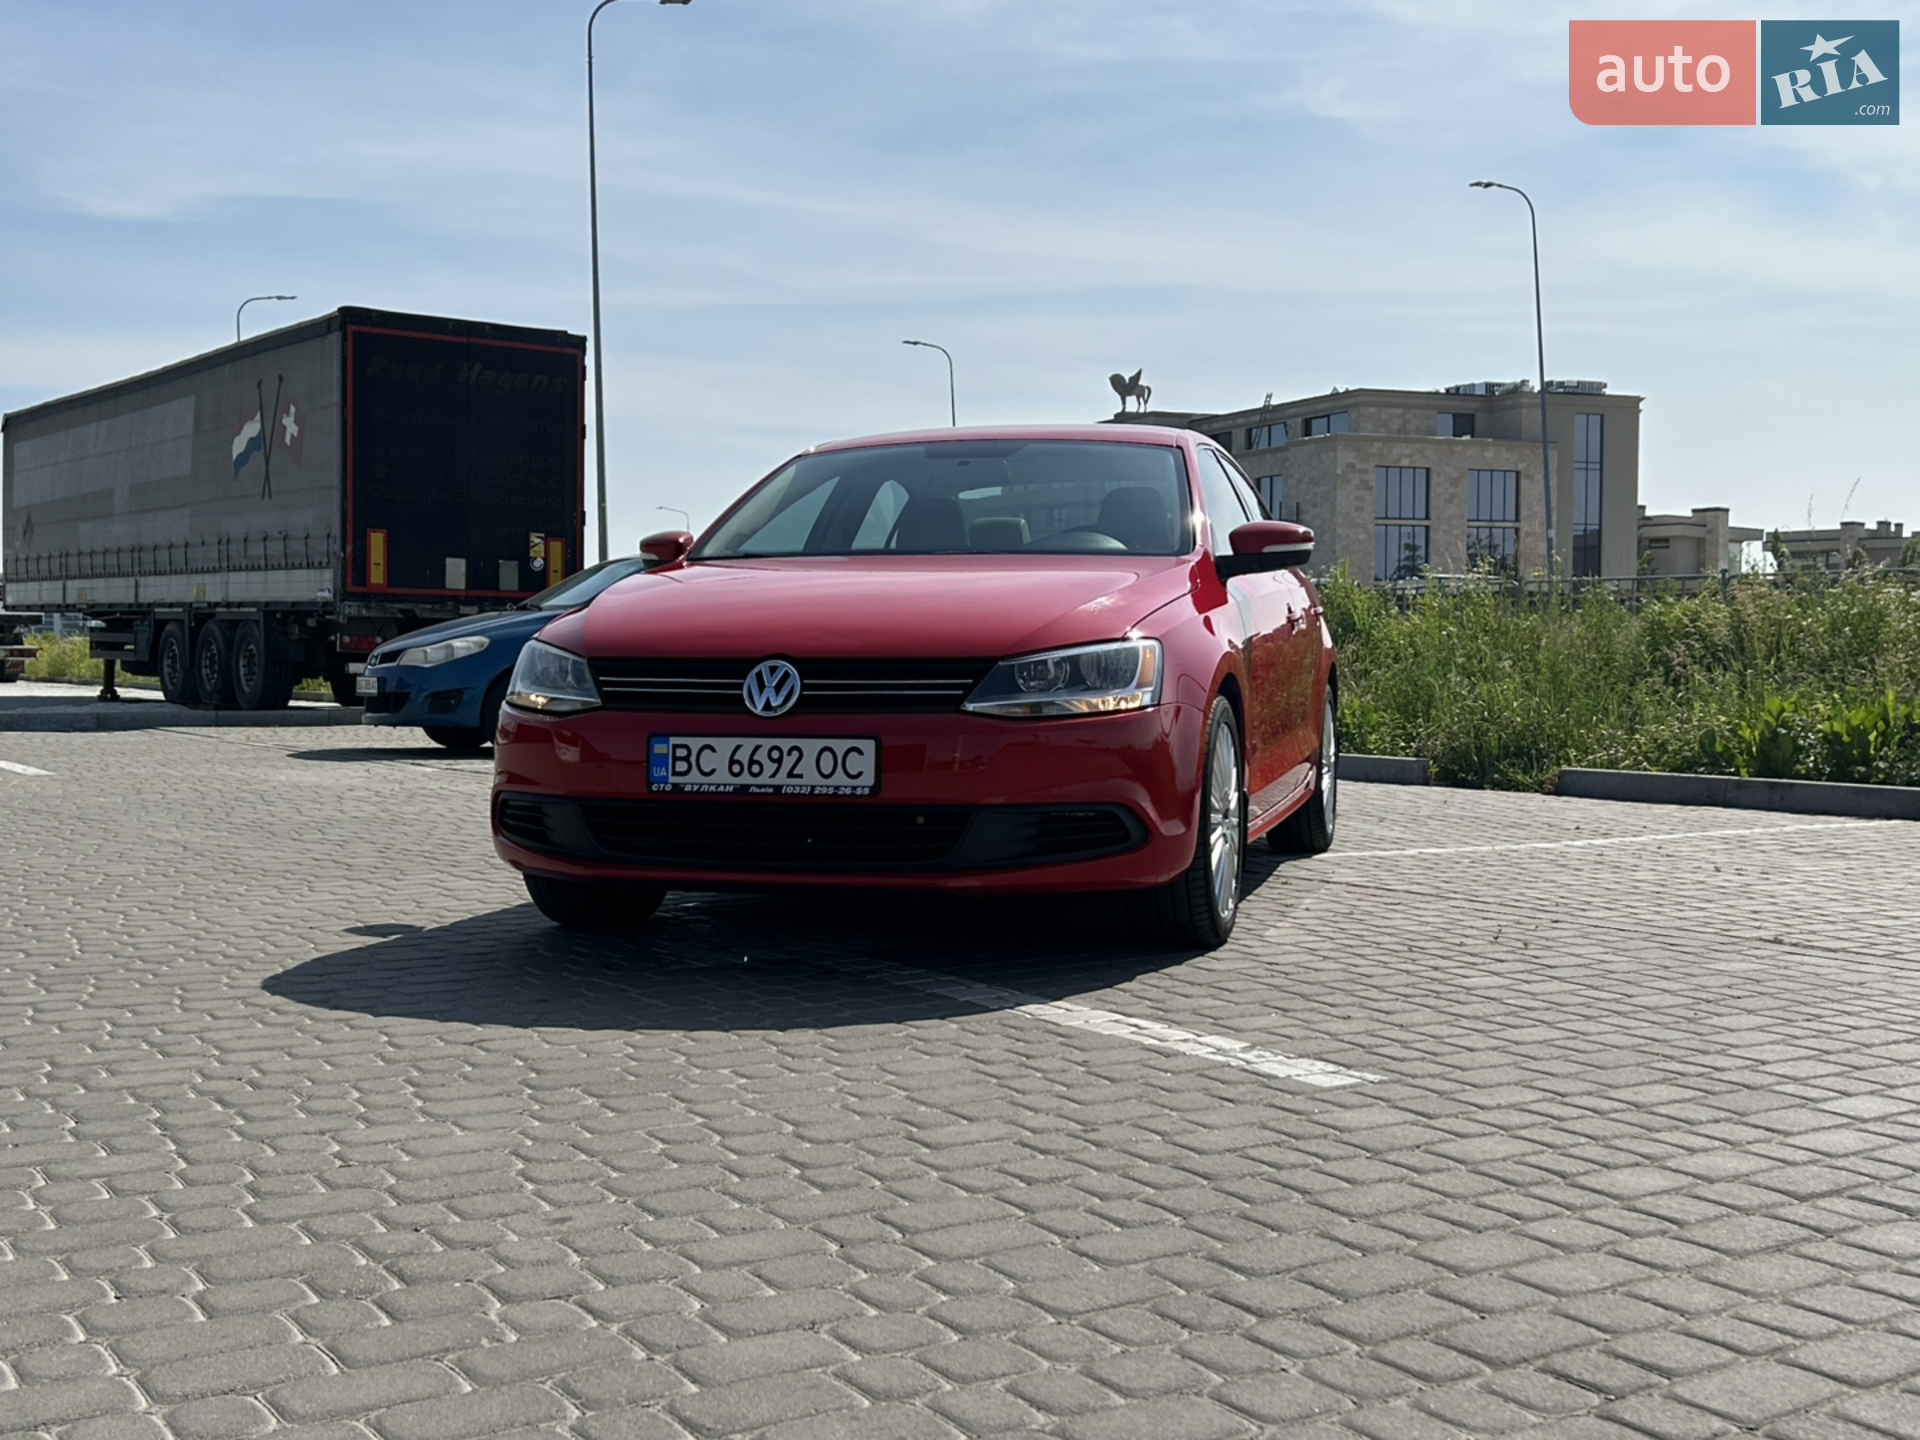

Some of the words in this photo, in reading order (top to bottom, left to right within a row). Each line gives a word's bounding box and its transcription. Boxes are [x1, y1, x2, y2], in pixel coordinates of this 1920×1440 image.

[457, 361, 567, 396] Hagens
[652, 766, 667, 777] UA
[671, 743, 717, 778] BC
[727, 744, 804, 780] 6692
[815, 745, 865, 780] OC
[651, 783, 673, 791] СТО
[782, 785, 811, 795] (032)
